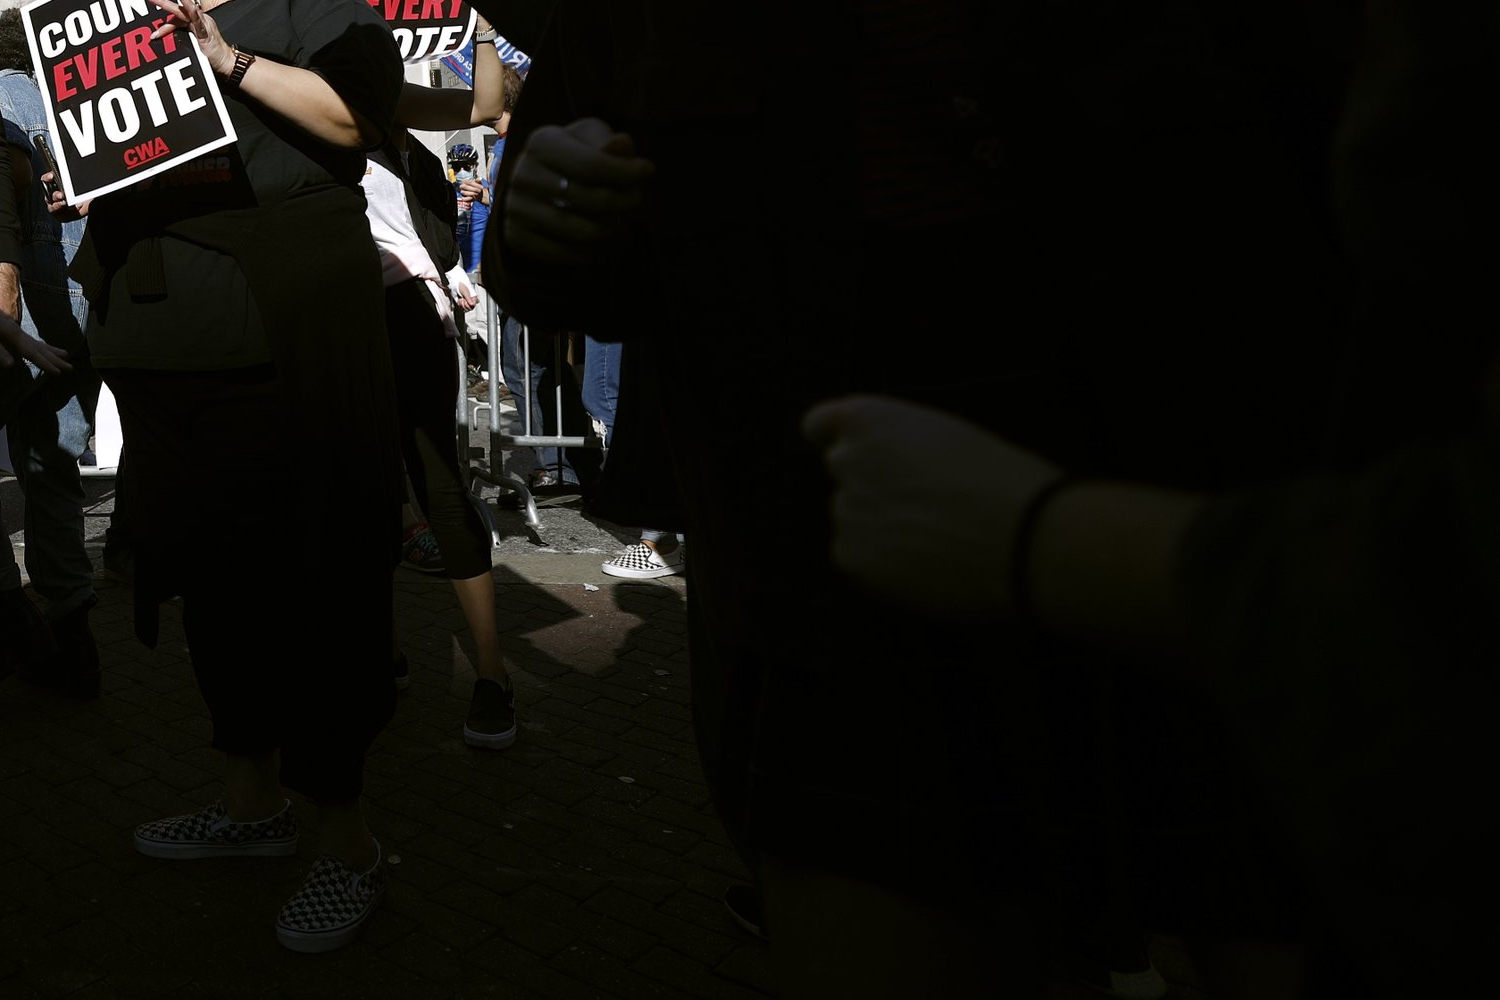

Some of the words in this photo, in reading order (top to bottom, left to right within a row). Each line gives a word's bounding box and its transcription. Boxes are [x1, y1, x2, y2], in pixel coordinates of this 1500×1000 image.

[392, 26, 463, 63] OTE
[59, 57, 206, 158] VOTE
[123, 137, 170, 169] CWA
